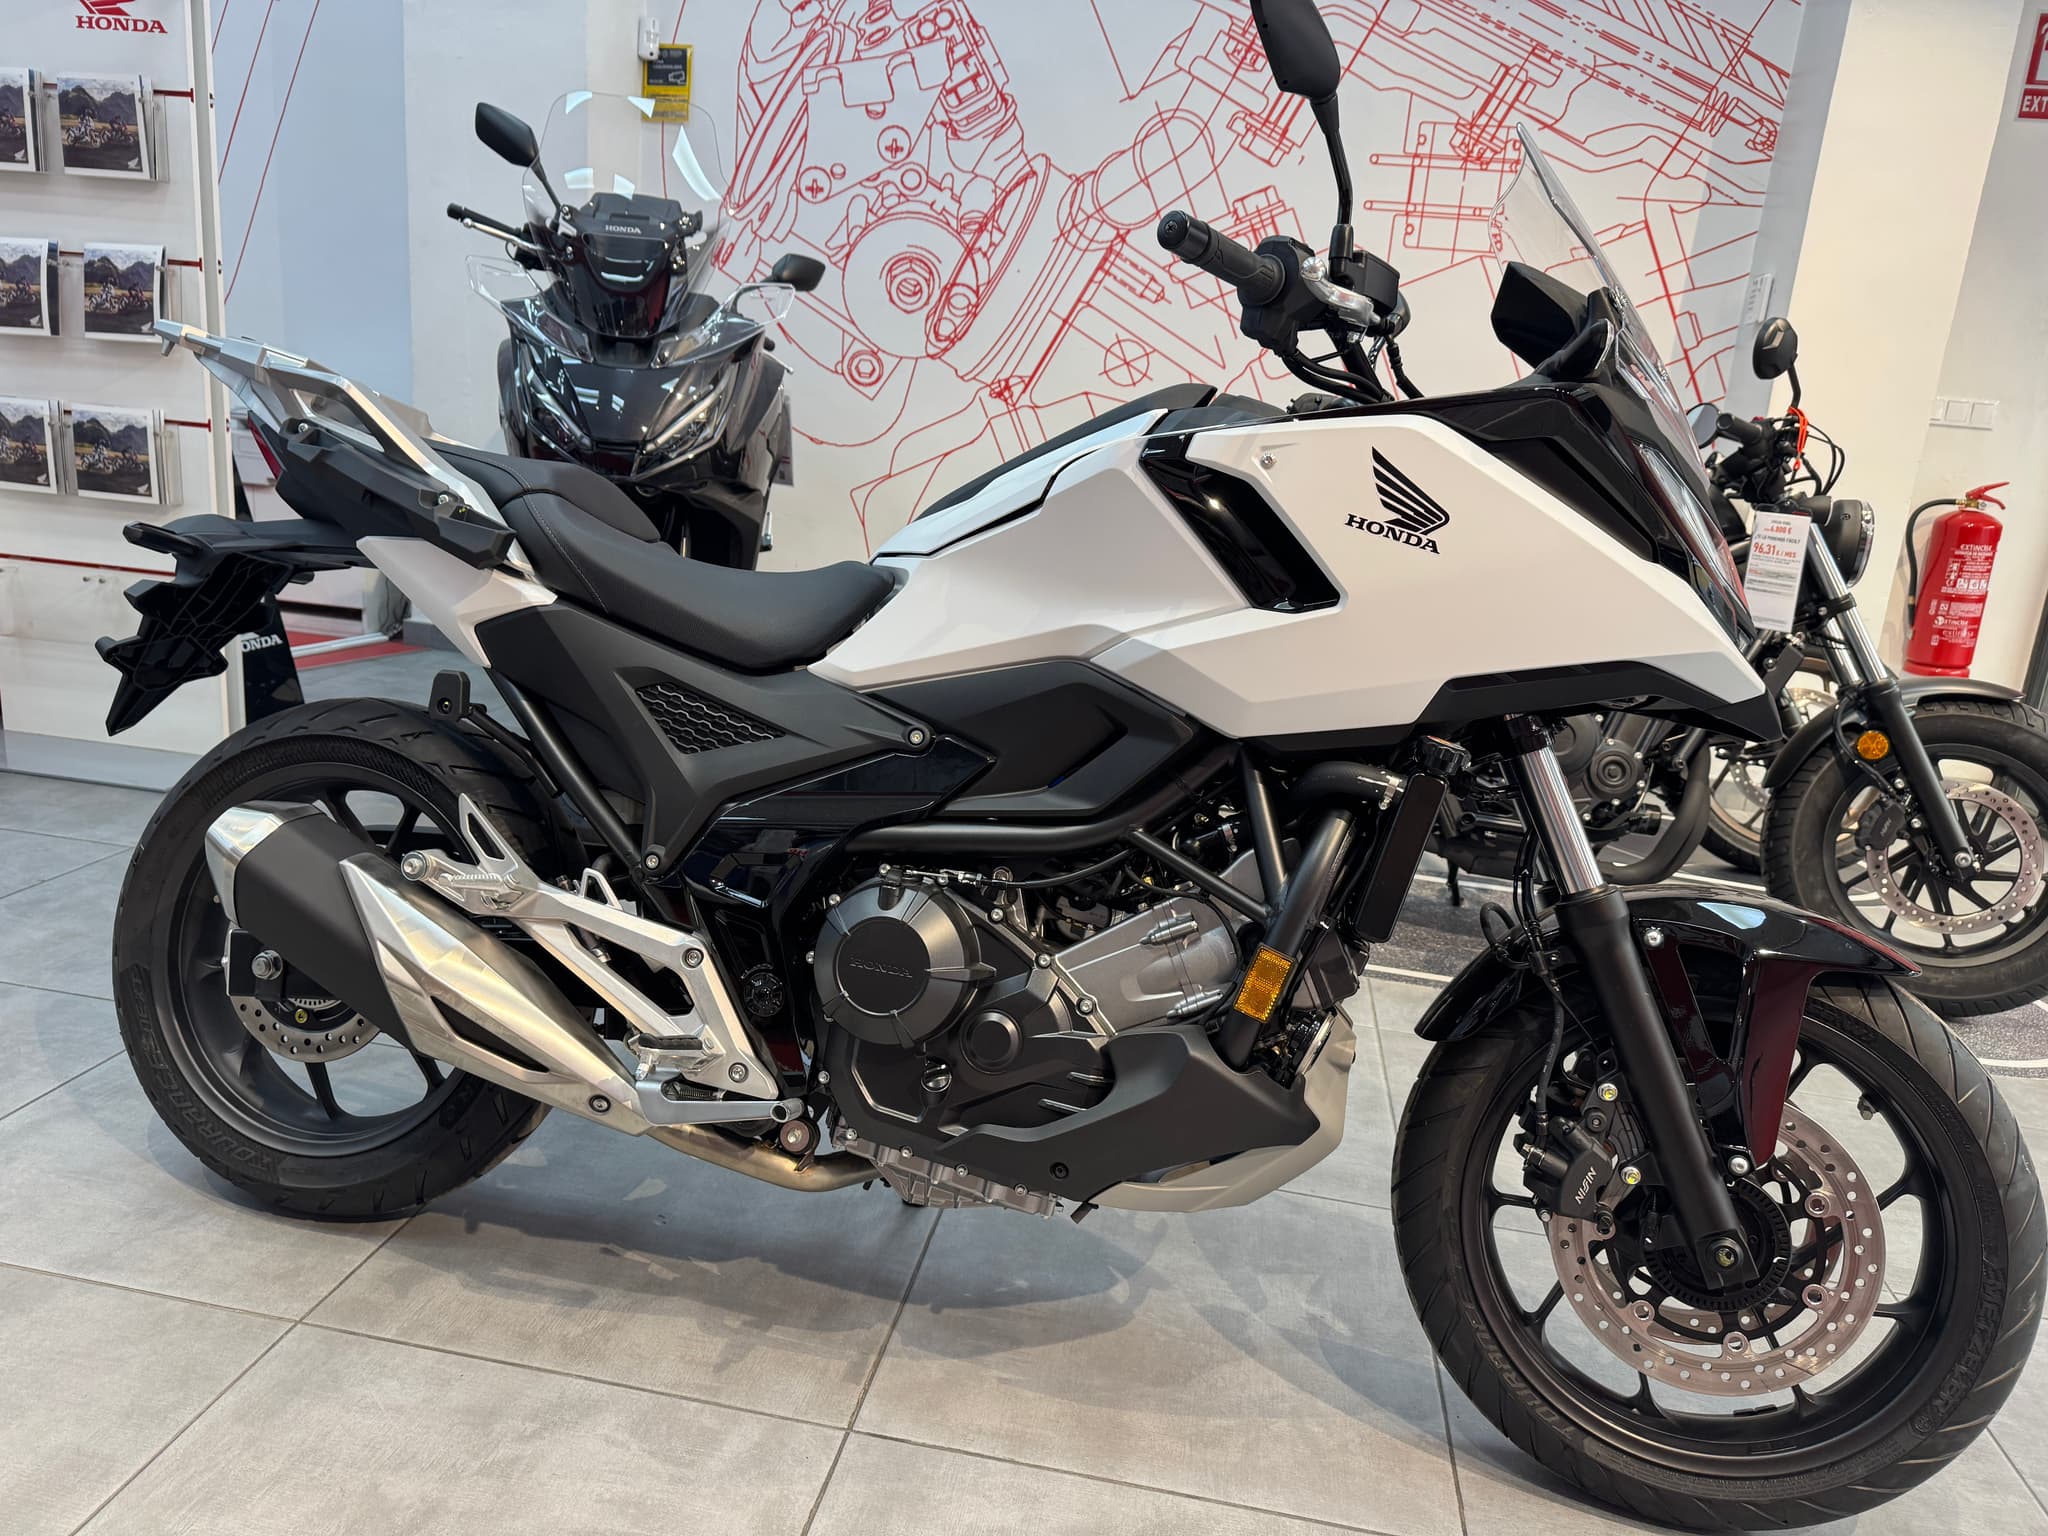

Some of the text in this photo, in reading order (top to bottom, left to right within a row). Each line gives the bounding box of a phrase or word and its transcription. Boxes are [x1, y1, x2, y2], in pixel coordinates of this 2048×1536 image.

[75, 15, 168, 34] HONDA
[605, 224, 642, 235] HONDA
[1344, 513, 1440, 554] HONDA
[241, 634, 284, 653] ONDA
[848, 956, 913, 978] HONDA
[1575, 1166, 1597, 1205] NISSIN
